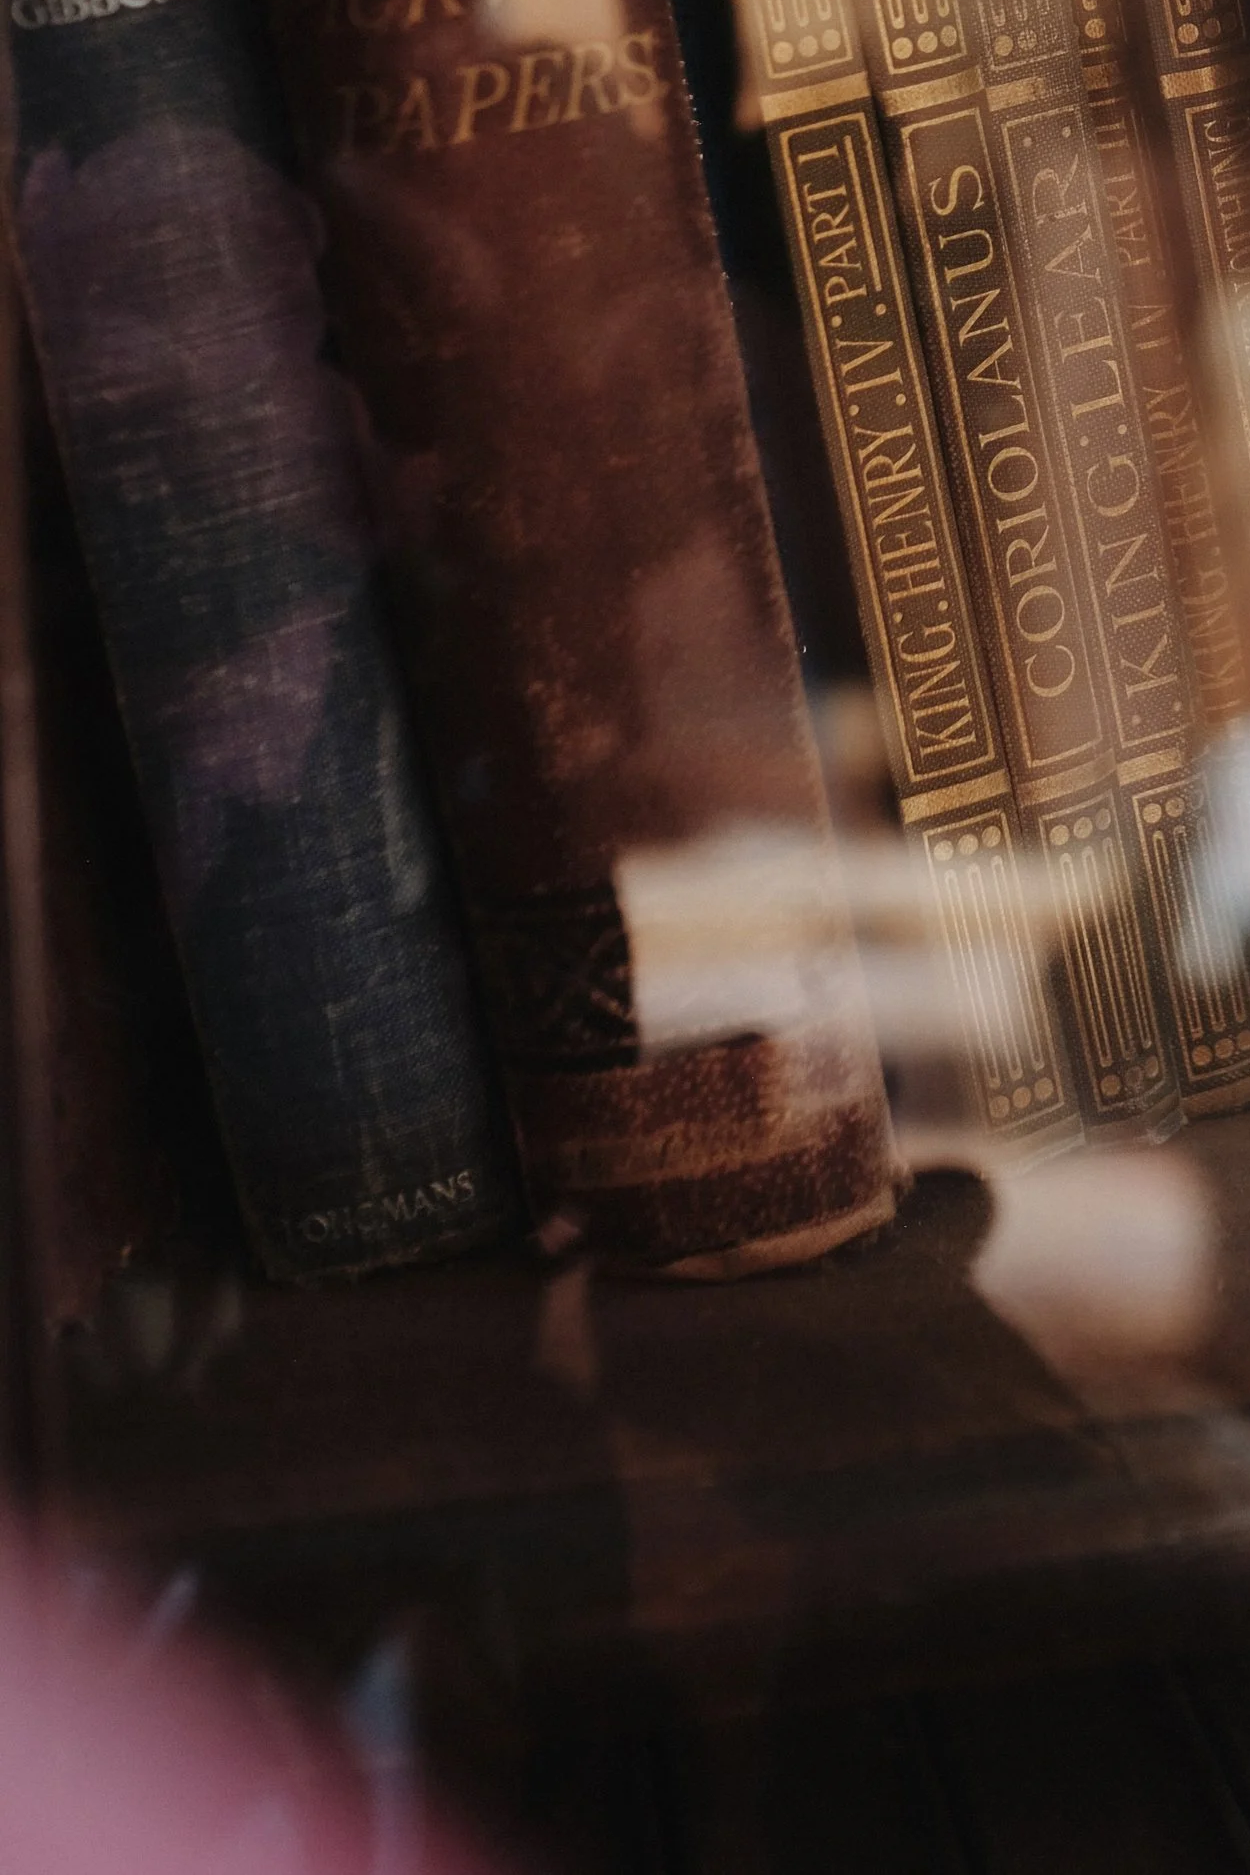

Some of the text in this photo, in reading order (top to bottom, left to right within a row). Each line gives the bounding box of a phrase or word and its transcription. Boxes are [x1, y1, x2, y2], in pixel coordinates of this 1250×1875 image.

[798, 143, 840, 171] I
[803, 180, 870, 307] PART
[932, 162, 1080, 701] CORIOLANUS
